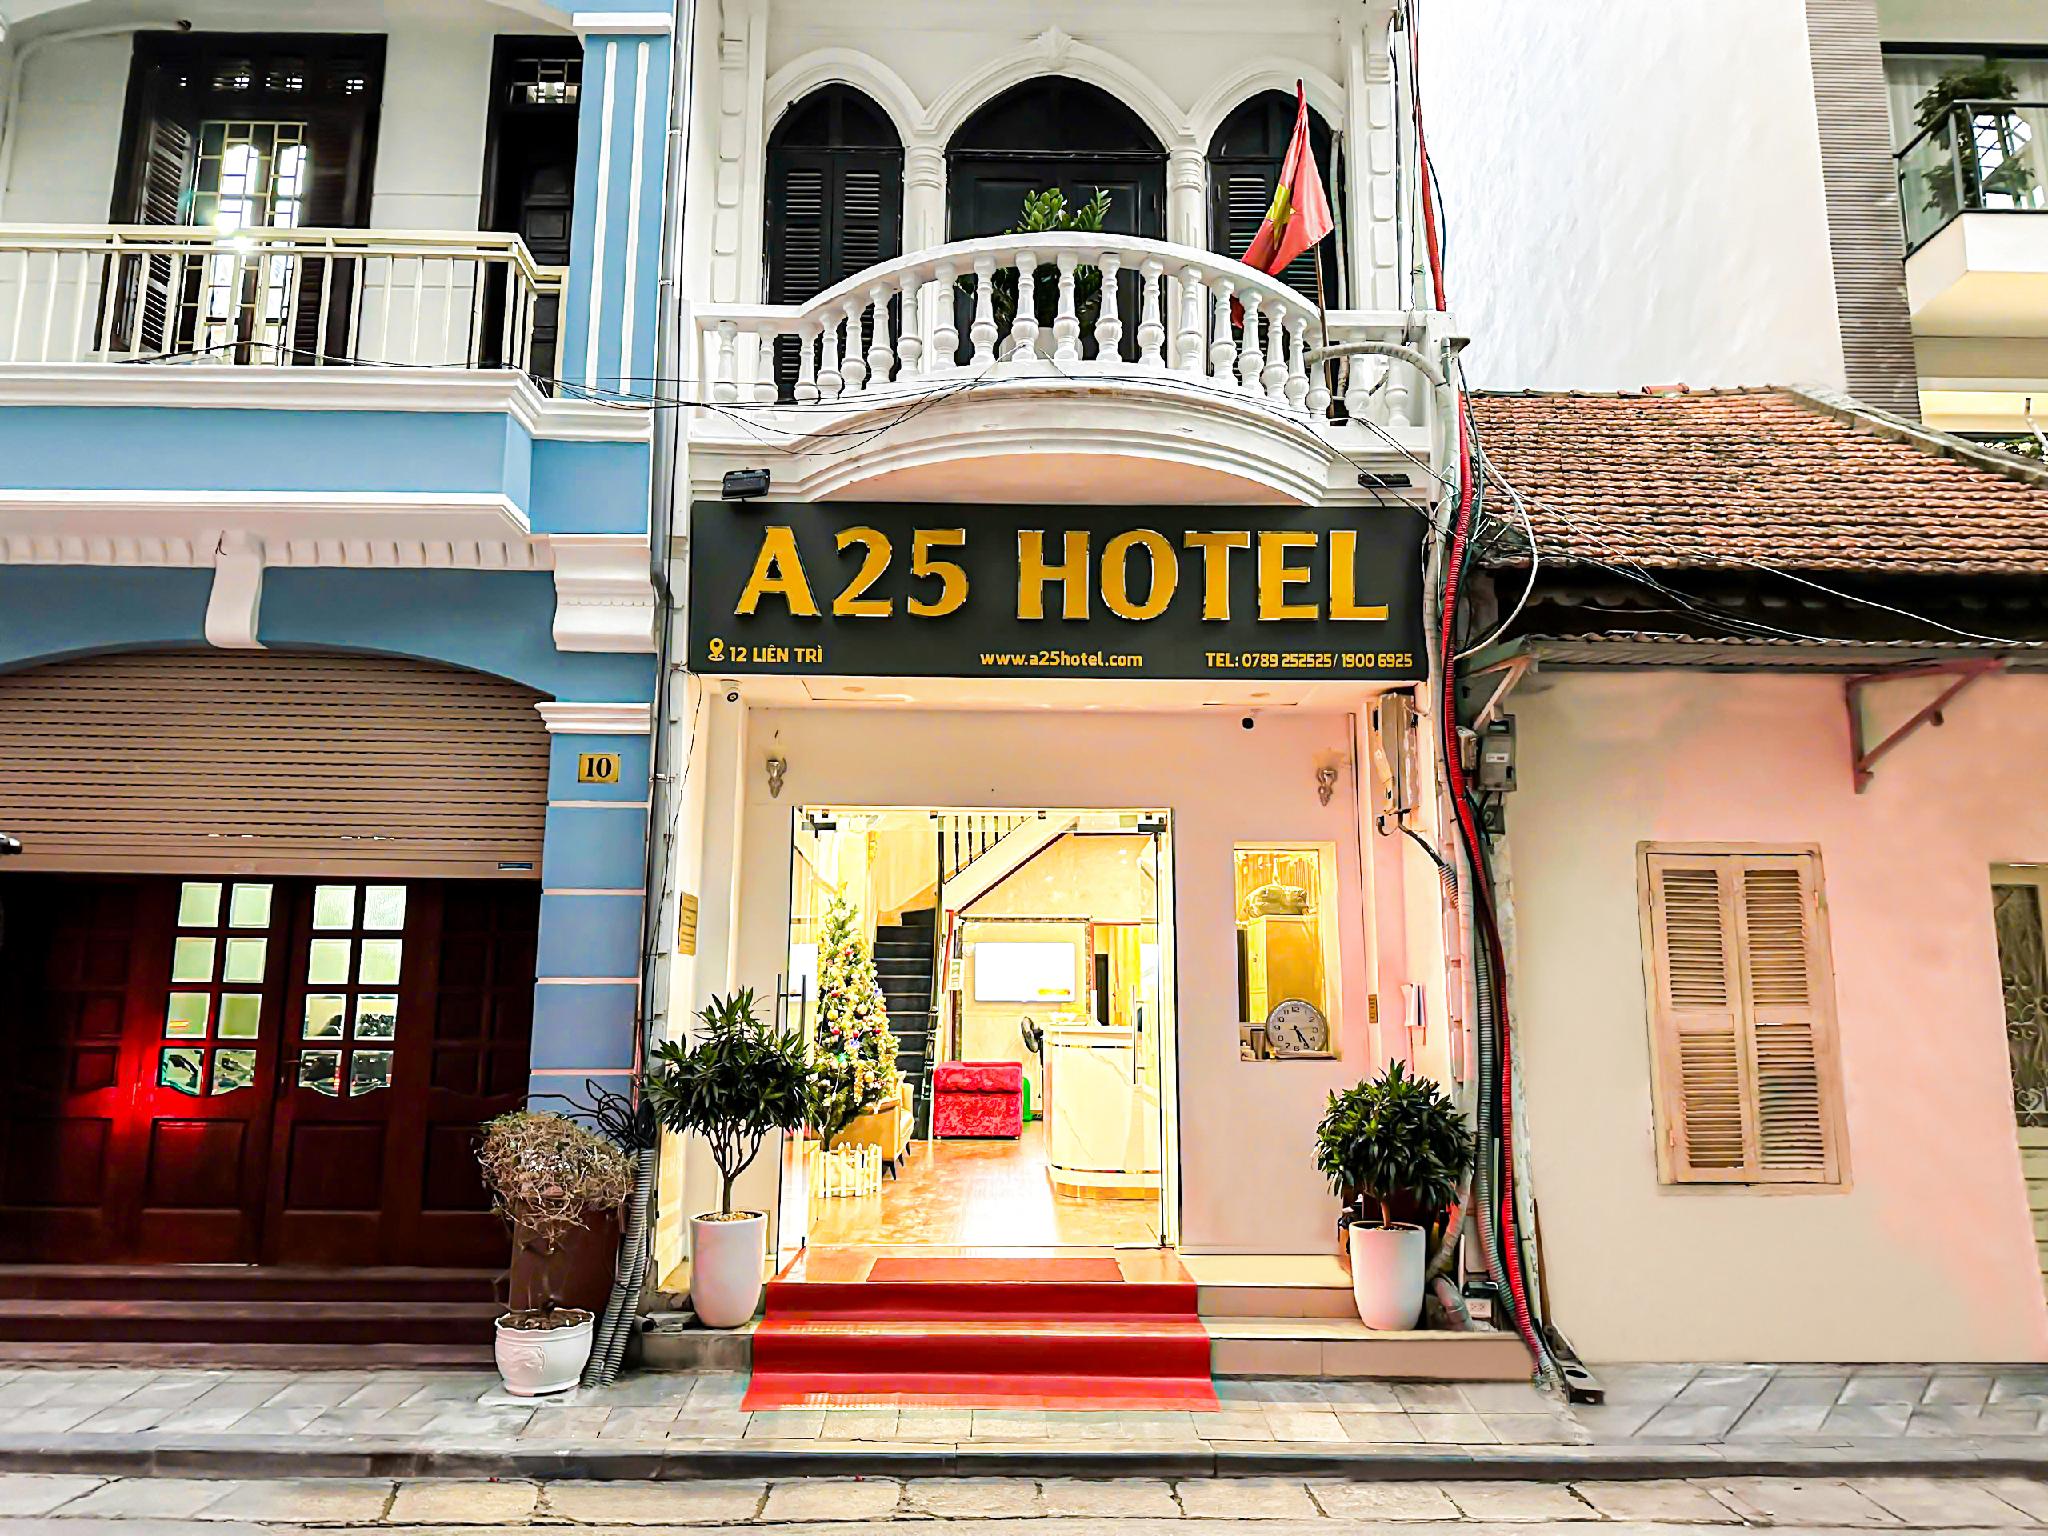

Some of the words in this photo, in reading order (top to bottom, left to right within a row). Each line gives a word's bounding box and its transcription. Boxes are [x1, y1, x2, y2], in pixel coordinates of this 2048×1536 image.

[734, 526, 969, 617] A25
[1017, 529, 1389, 621] HOTEL
[729, 646, 747, 662] 12
[752, 644, 789, 663] LIÊN
[793, 644, 823, 663] TRÌ
[980, 650, 1143, 667] www.a25hotel.com
[1205, 652, 1239, 668] TEL:
[1242, 653, 1279, 668] 0789
[1341, 653, 1375, 668] 1900
[1377, 653, 1413, 668] 6925
[586, 757, 612, 778] 10
